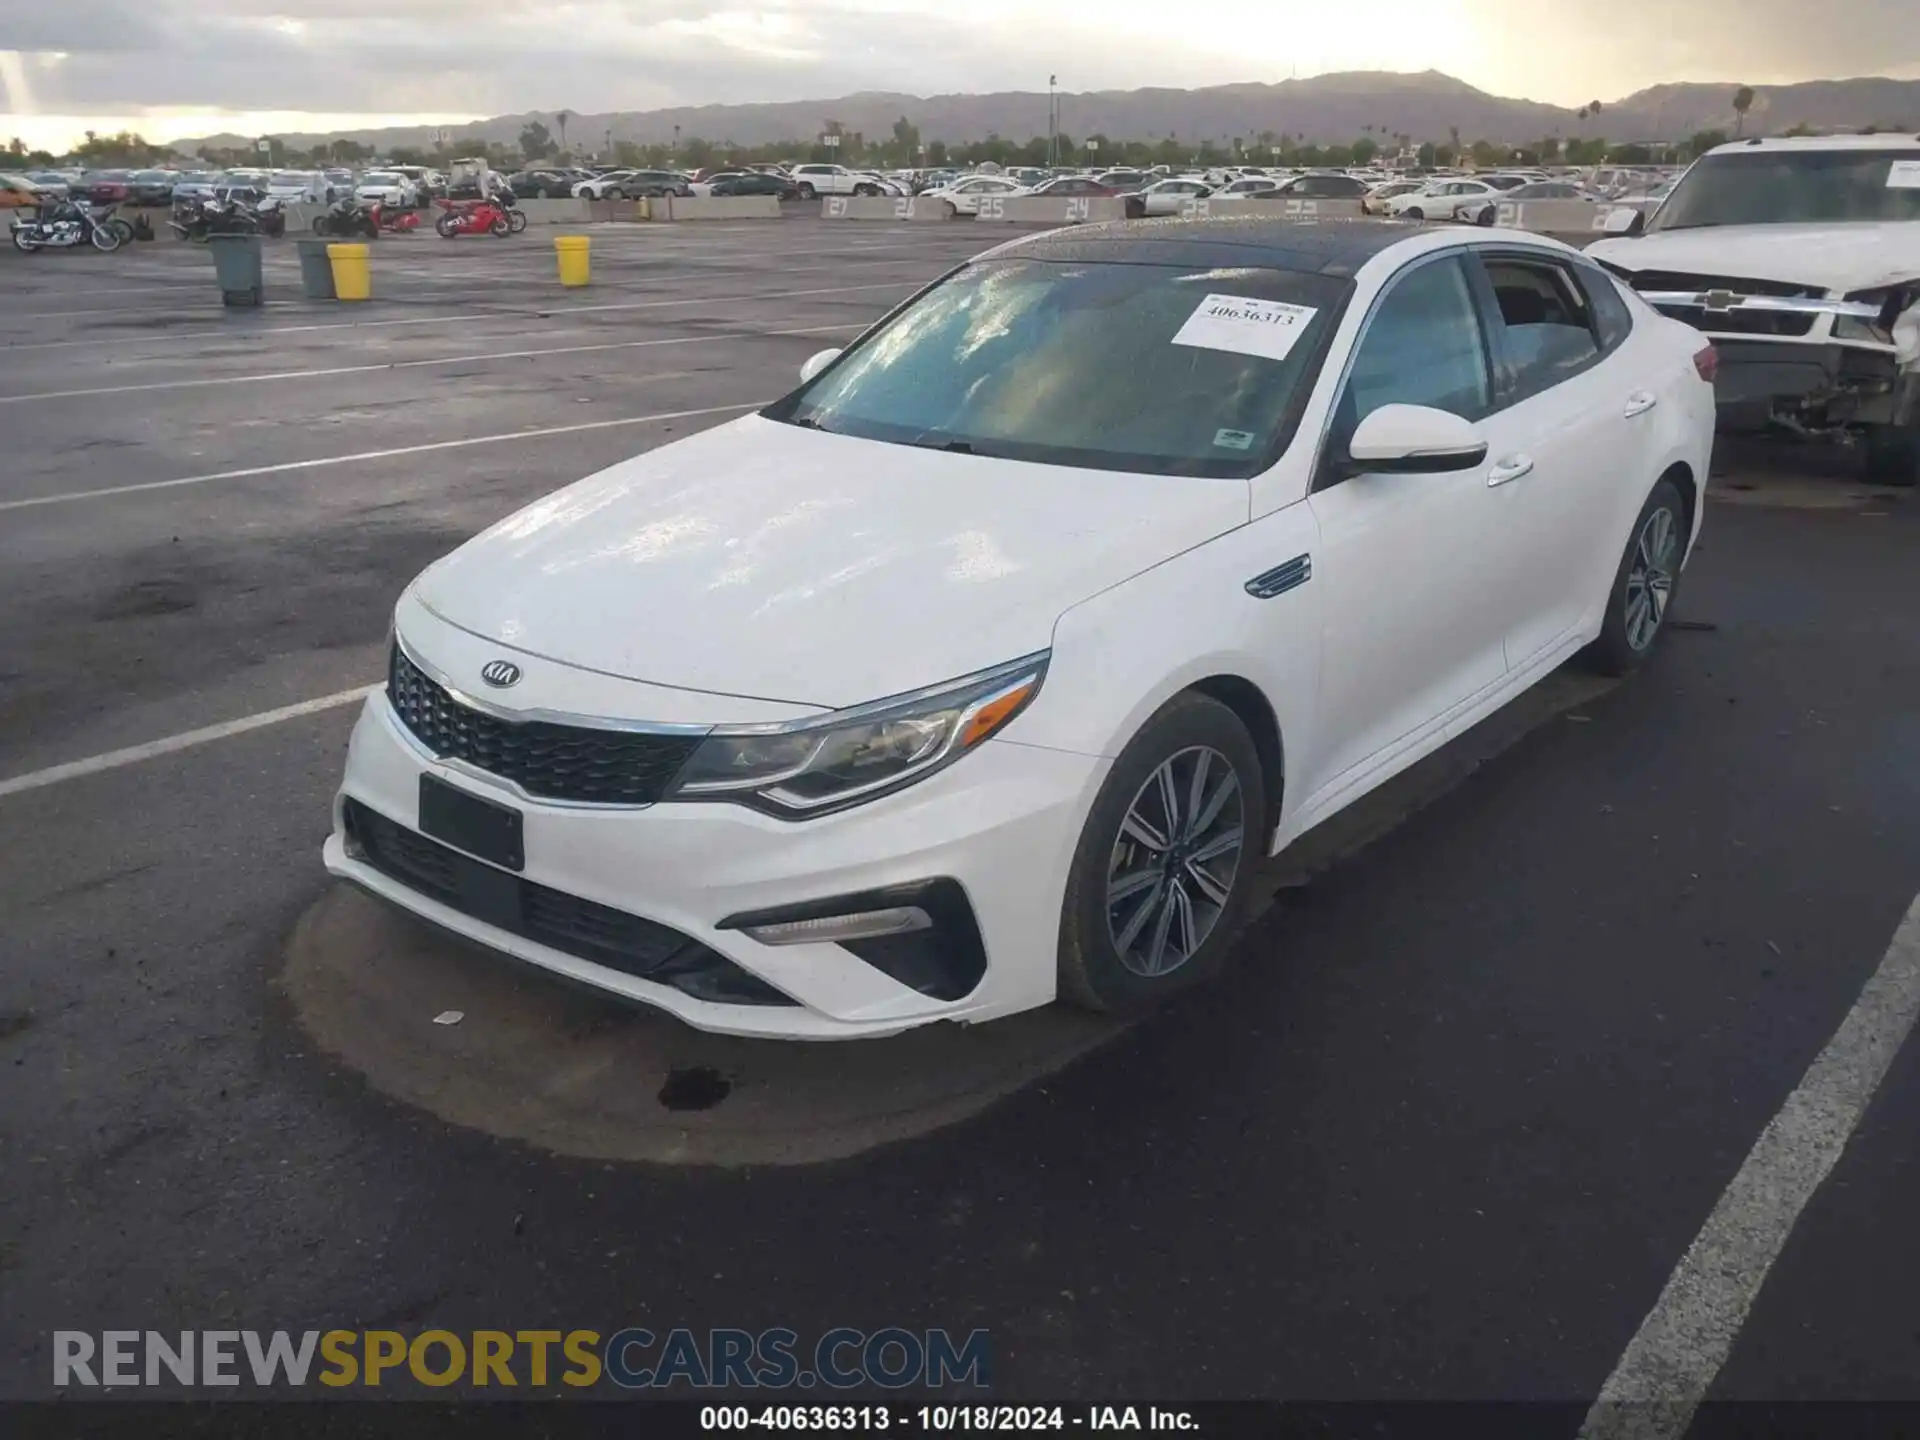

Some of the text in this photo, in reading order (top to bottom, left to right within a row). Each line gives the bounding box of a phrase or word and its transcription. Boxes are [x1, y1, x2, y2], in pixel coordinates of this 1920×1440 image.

[980, 198, 1004, 219] 25
[1064, 197, 1089, 219] 24
[1497, 203, 1524, 229] 21
[1207, 305, 1294, 326] 40636313
[484, 663, 514, 684] KIA
